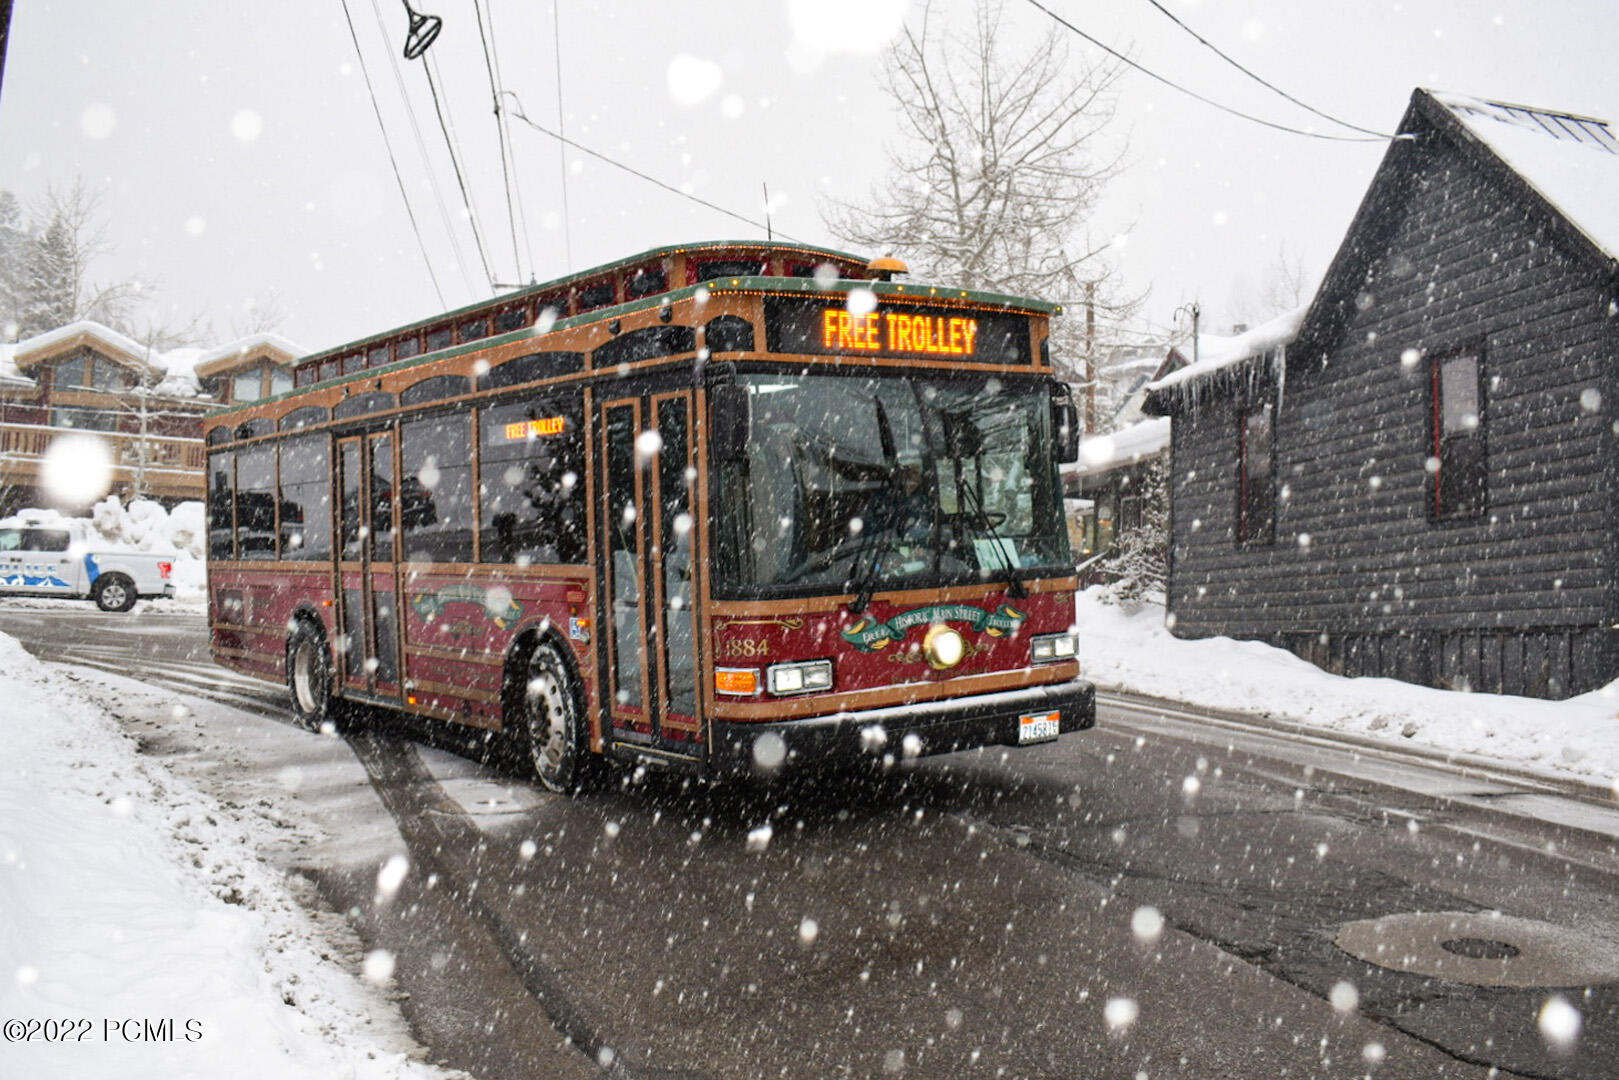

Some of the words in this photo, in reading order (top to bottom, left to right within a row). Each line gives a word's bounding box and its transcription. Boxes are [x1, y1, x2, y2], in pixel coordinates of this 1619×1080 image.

[823, 309, 881, 350] FREE
[886, 313, 977, 354] TROLLEY
[505, 421, 527, 440] FREE
[725, 638, 769, 657] 1884
